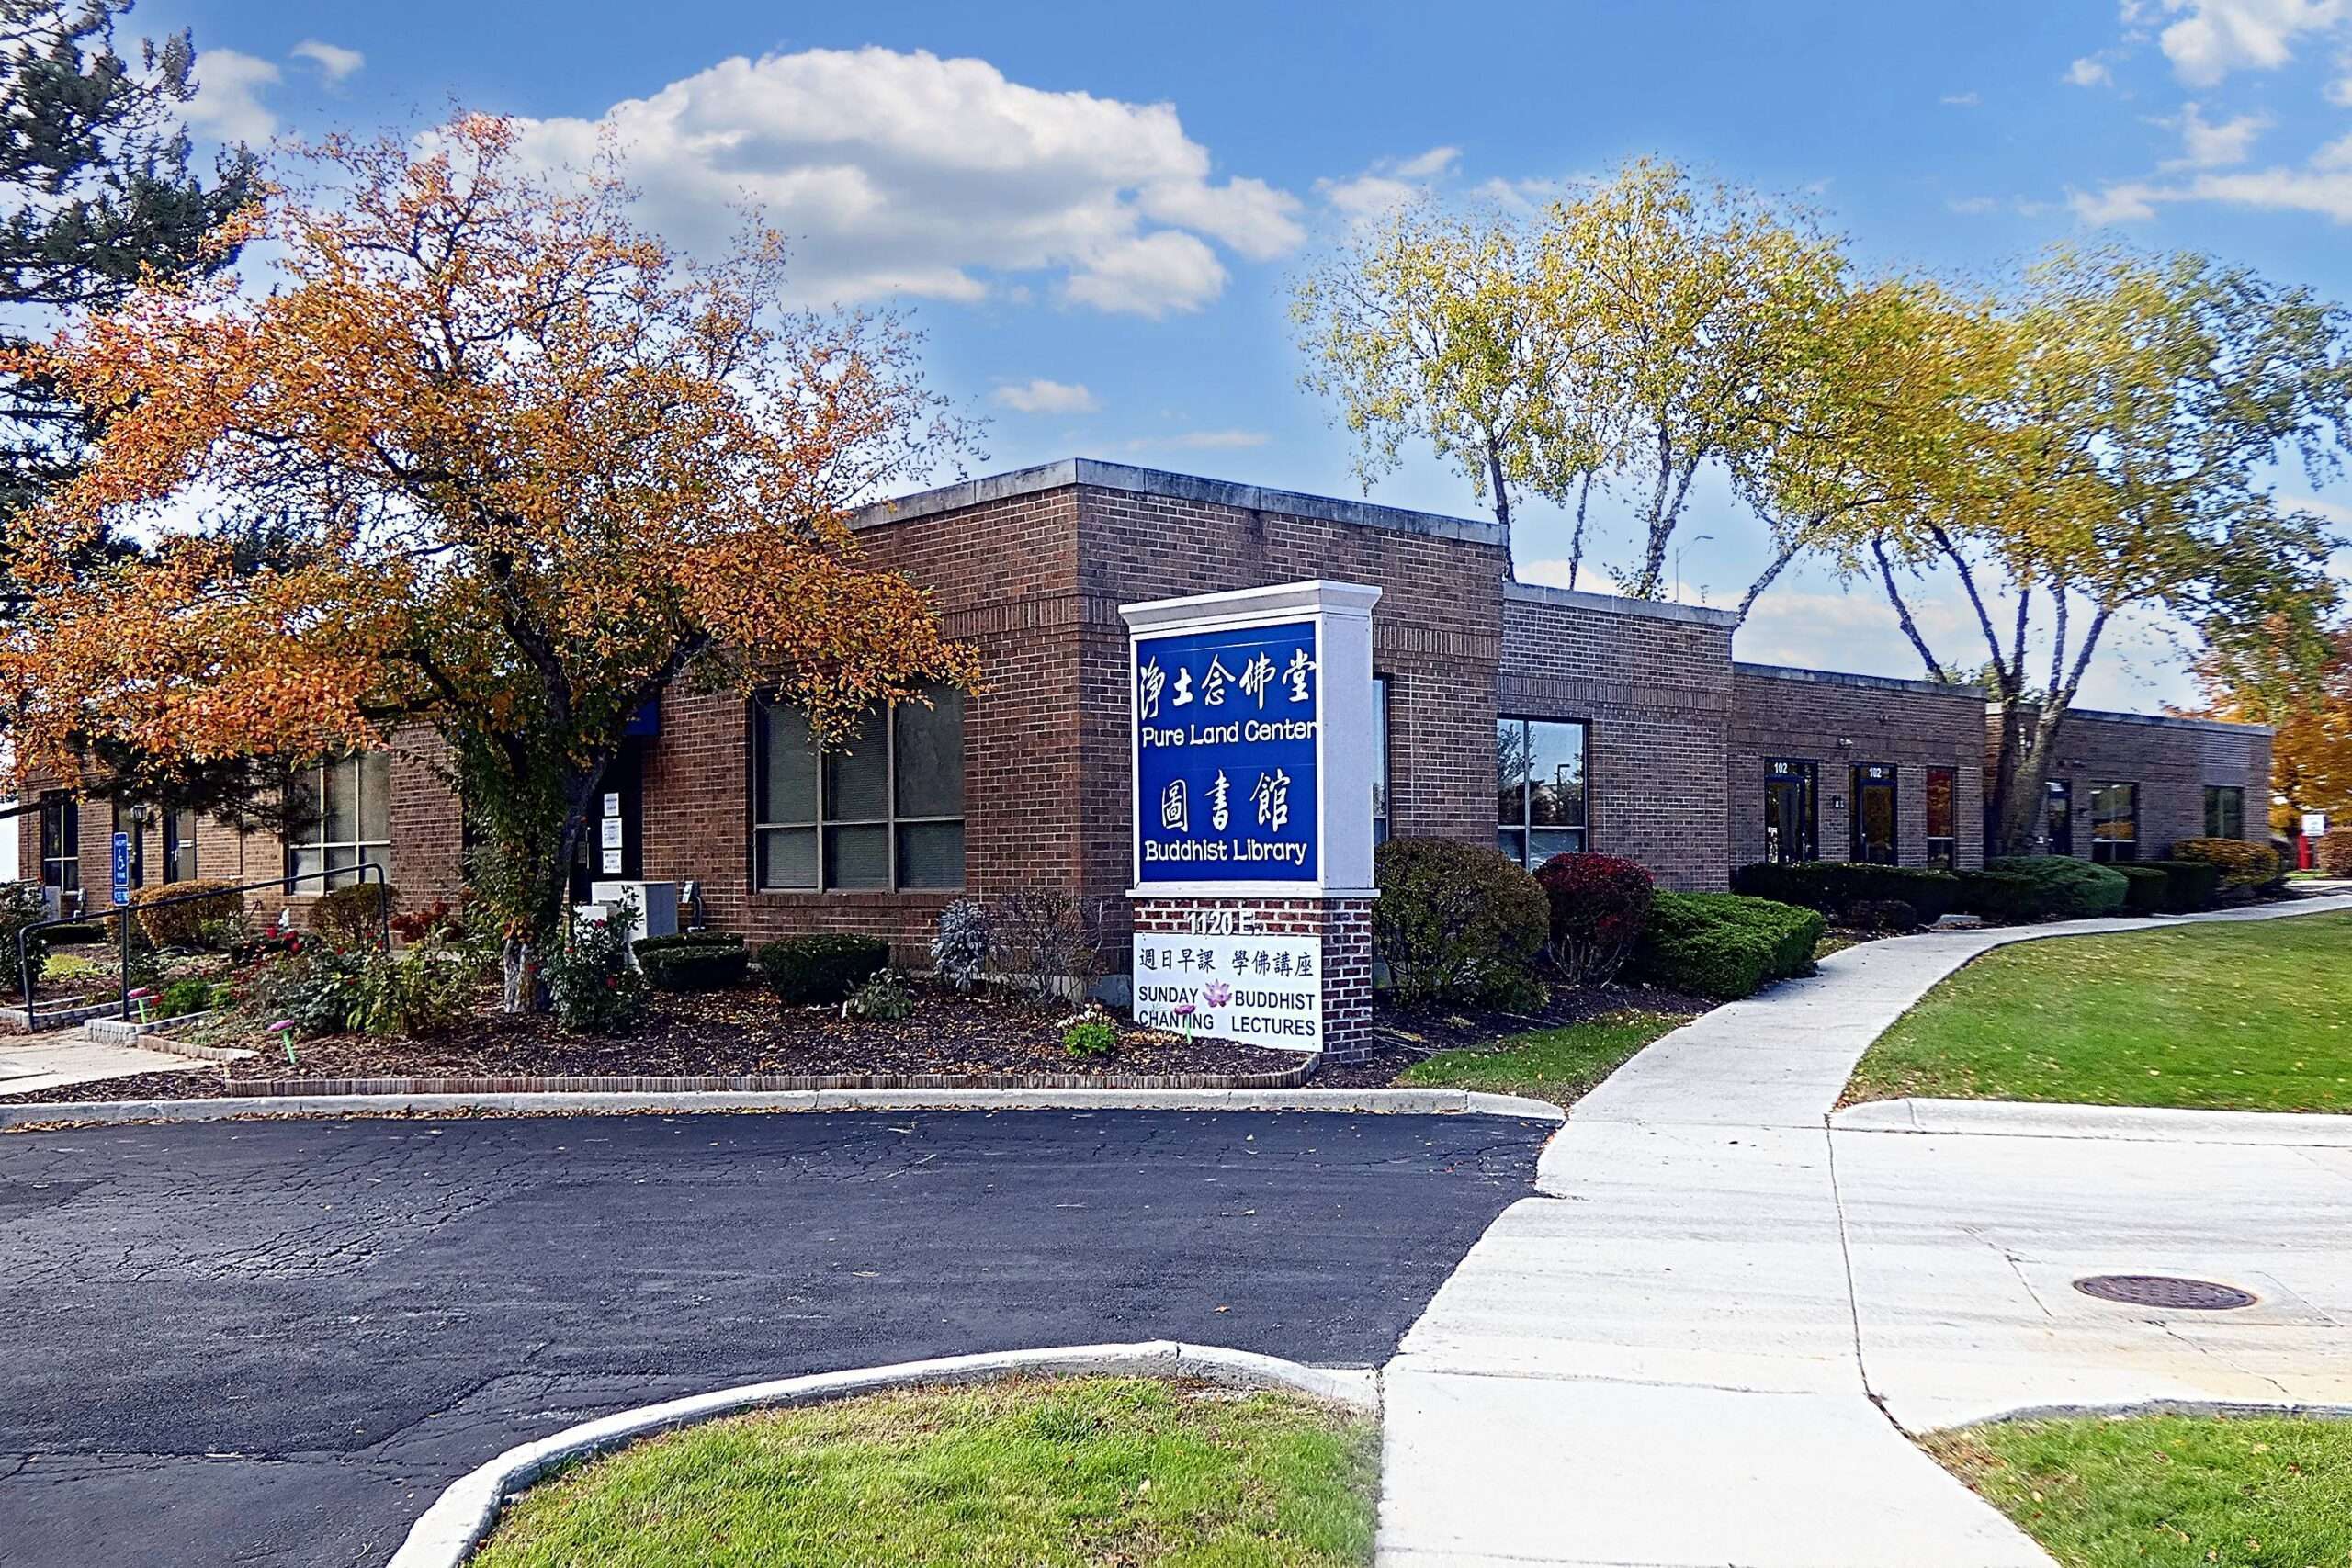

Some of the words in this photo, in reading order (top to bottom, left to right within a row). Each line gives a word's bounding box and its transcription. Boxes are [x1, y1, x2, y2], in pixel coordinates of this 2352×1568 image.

[1142, 727, 1184, 747] Pure
[1190, 721, 1239, 745] Land
[1244, 717, 1317, 742] Center
[1774, 762, 1788, 773] 102
[1161, 768, 1291, 832] 圖書館
[1145, 838, 1228, 862] Buddhist
[1233, 838, 1307, 866] Library
[1187, 911, 1233, 935] 1120
[1139, 948, 1216, 973] 週日早課
[1231, 951, 1314, 977] 學佛講座
[1138, 986, 1198, 1004] SUNDAY
[1236, 990, 1315, 1010] BUDDHIST
[1232, 1015, 1315, 1036] LECTURES
